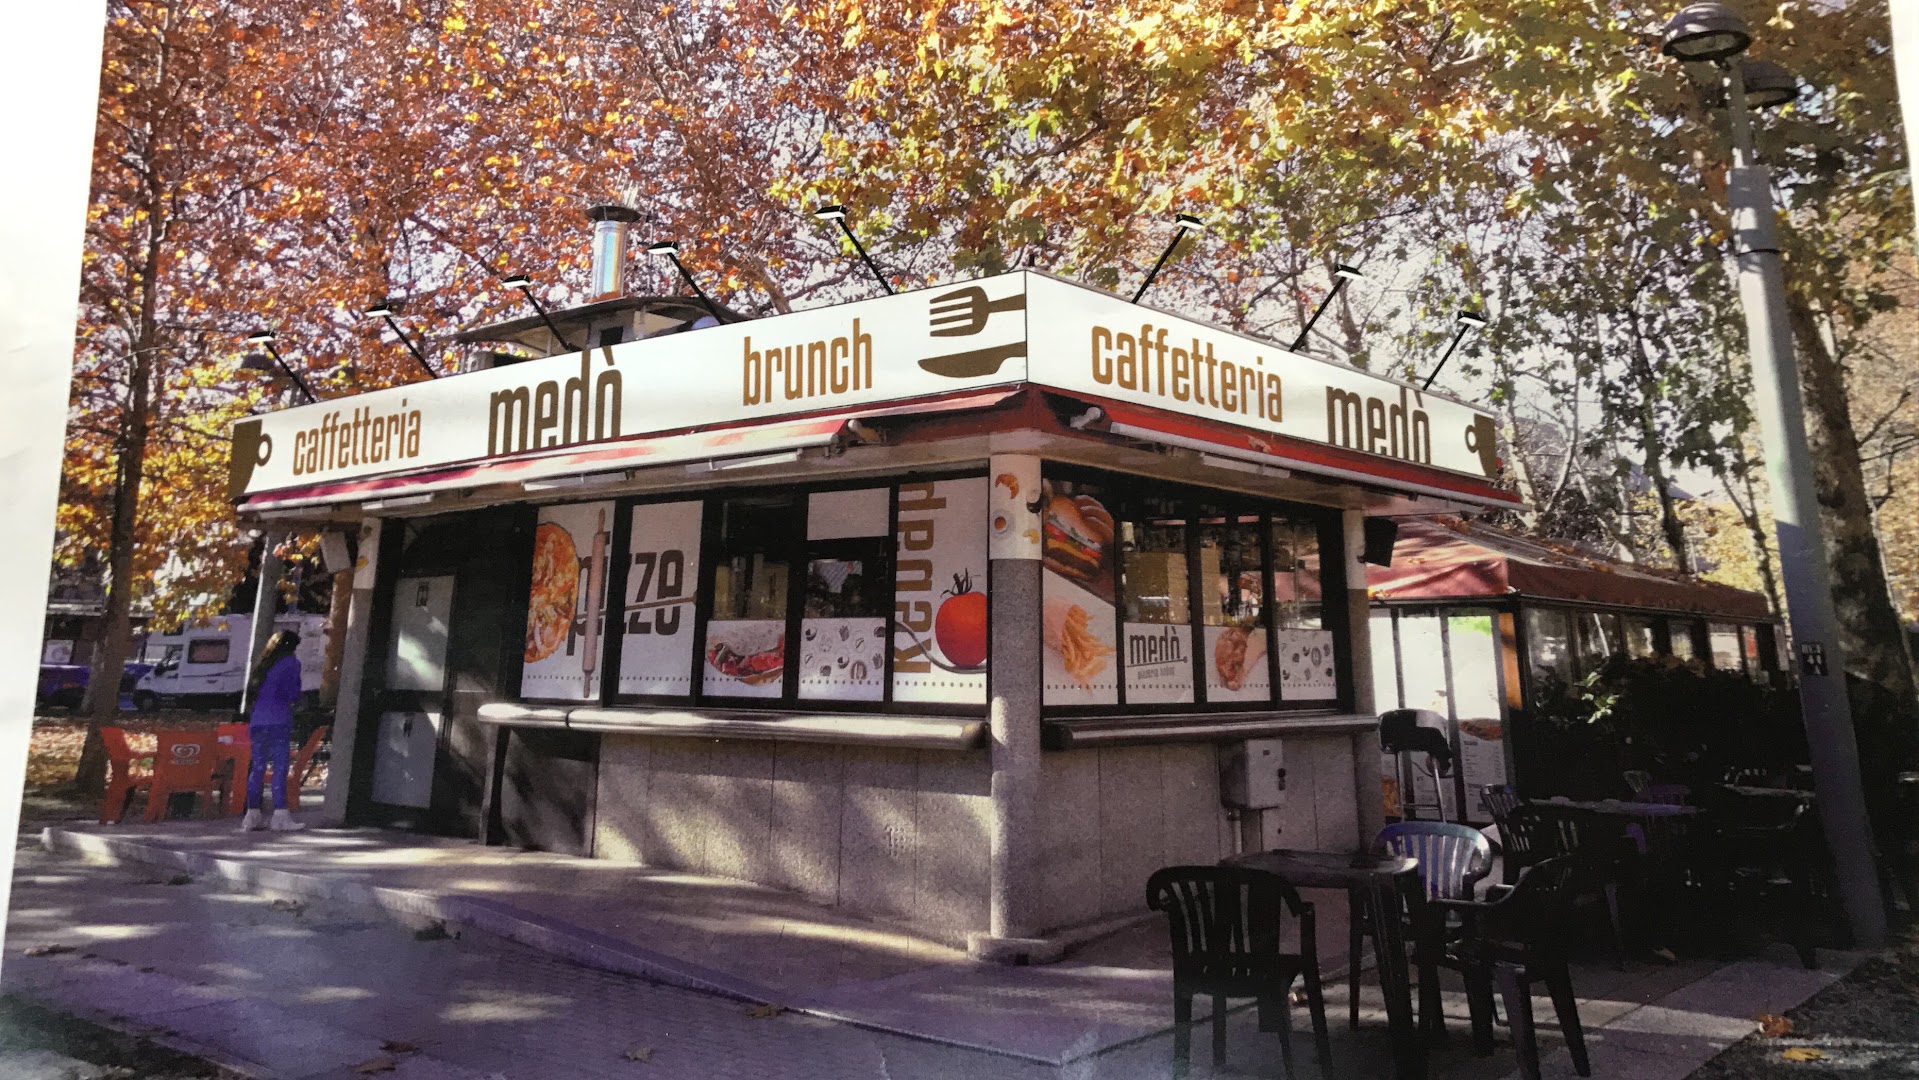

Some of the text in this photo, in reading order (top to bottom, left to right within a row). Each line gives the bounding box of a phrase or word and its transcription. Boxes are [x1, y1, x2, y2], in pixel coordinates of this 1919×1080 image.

[292, 318, 873, 477] caffetteria medò brunch
[1092, 323, 1431, 466] caffetteria medò
[1129, 625, 1181, 664] medò
